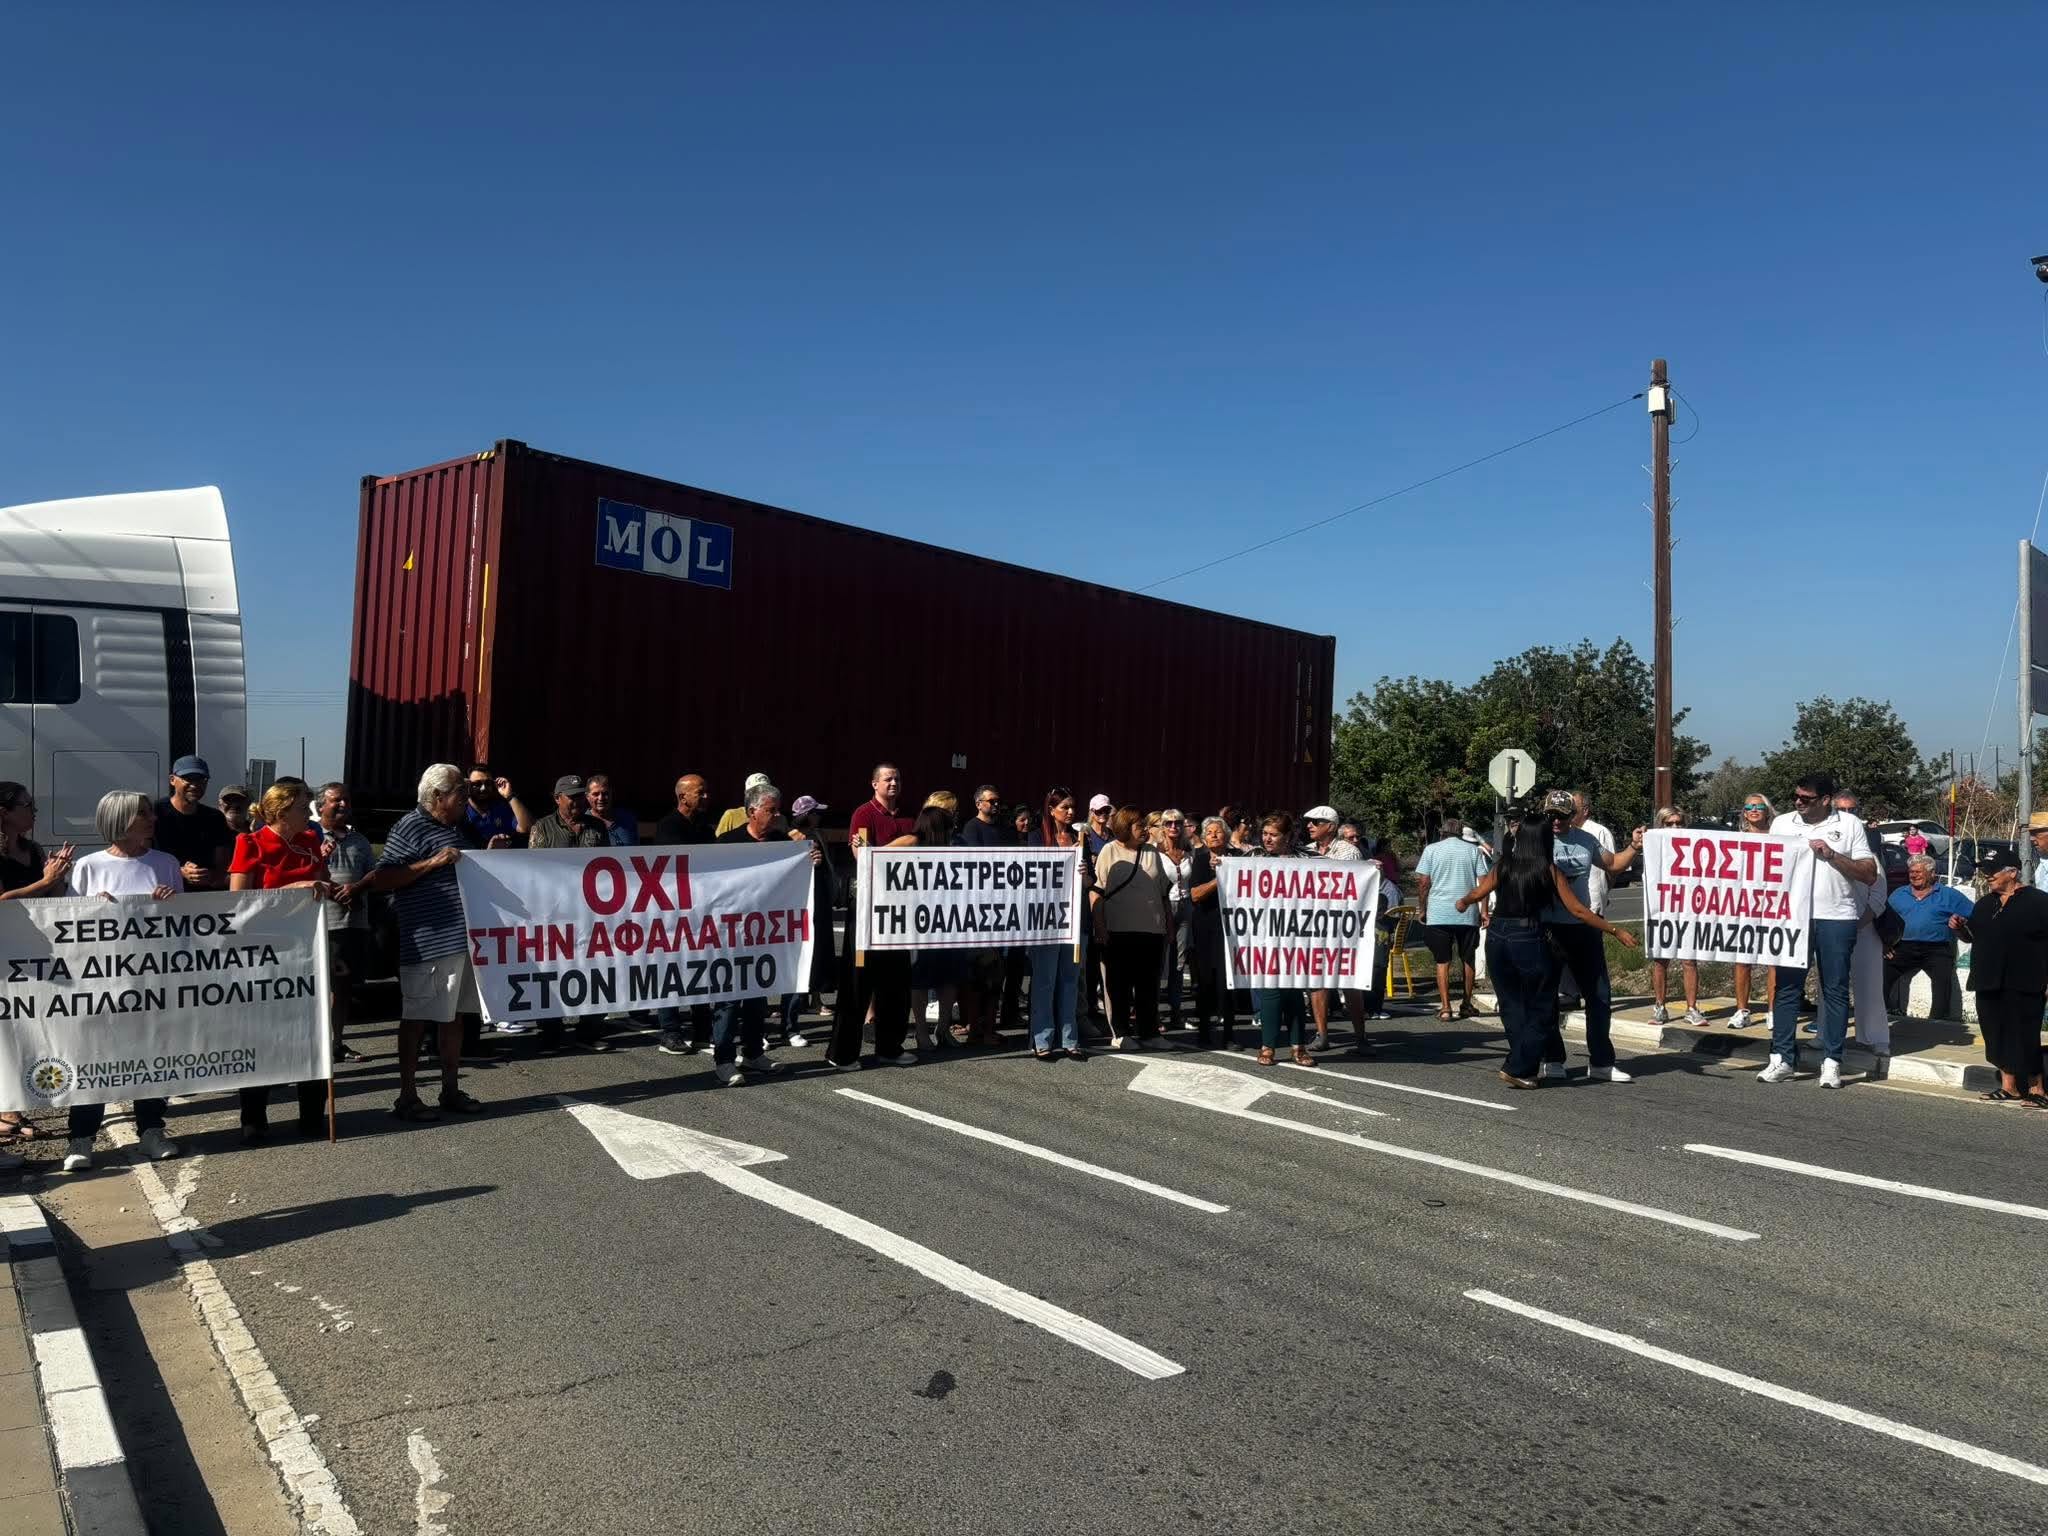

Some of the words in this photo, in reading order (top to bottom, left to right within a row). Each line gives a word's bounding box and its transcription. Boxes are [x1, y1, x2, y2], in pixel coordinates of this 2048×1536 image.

[604, 515, 725, 573] MOL
[886, 861, 1065, 891] ΚΑΤΑΣΤΡΕΦΕΤΕ
[1670, 837, 1784, 883] ΣΩΣΤΕ
[582, 855, 692, 916] ΟΧΙ
[1237, 869, 1253, 898] Η
[1258, 869, 1358, 900] ΘΑΛΑΣΣΑ
[1657, 883, 1686, 913] ΤΗ
[1691, 885, 1792, 920] ΘΑΛΑΣΣΑ
[54, 912, 237, 944] ΣΕΒΑΣΜΟΣ
[874, 905, 906, 934] ΤΗ
[915, 903, 1020, 933] ΘΑΛΑΣΣΑ
[1027, 901, 1070, 931] ΜΑΣ
[1222, 907, 1264, 937] ΤΟΥ
[1269, 908, 1371, 938] ΜΑΖΩΤΟΥ
[469, 924, 574, 966] ΣΤΗΝ
[586, 908, 809, 958] ΑΦΑΛΑΤΩΣΗ
[1647, 919, 1689, 949] ΤΟΥ
[1693, 922, 1802, 957] ΜΑΖΩΤΟΥ
[7, 957, 72, 983] ΣΤΑ
[81, 944, 279, 979] ΔΙΚΑΙΩΜΑΤΑ
[1233, 946, 1357, 976] ΚΙΝΔΥΝΕΥΕΙ
[46, 987, 166, 1018] ΑΠΛΩΝ
[178, 974, 315, 1009] ΠΟΛΙΤΩΝ
[508, 967, 616, 1012] ΣΤΟΝ
[629, 953, 777, 1002] ΜΑΖΩΤΟ
[76, 1059, 148, 1077] ΚΙΝΗΜΑ
[152, 1047, 256, 1068] ΟΙΚΟΛΟΓΩΝ
[76, 1069, 178, 1090] ΣΥΝΕΡΓΑΣΙΑ
[182, 1061, 256, 1080] ΠΟΛΙΤΩΝ
